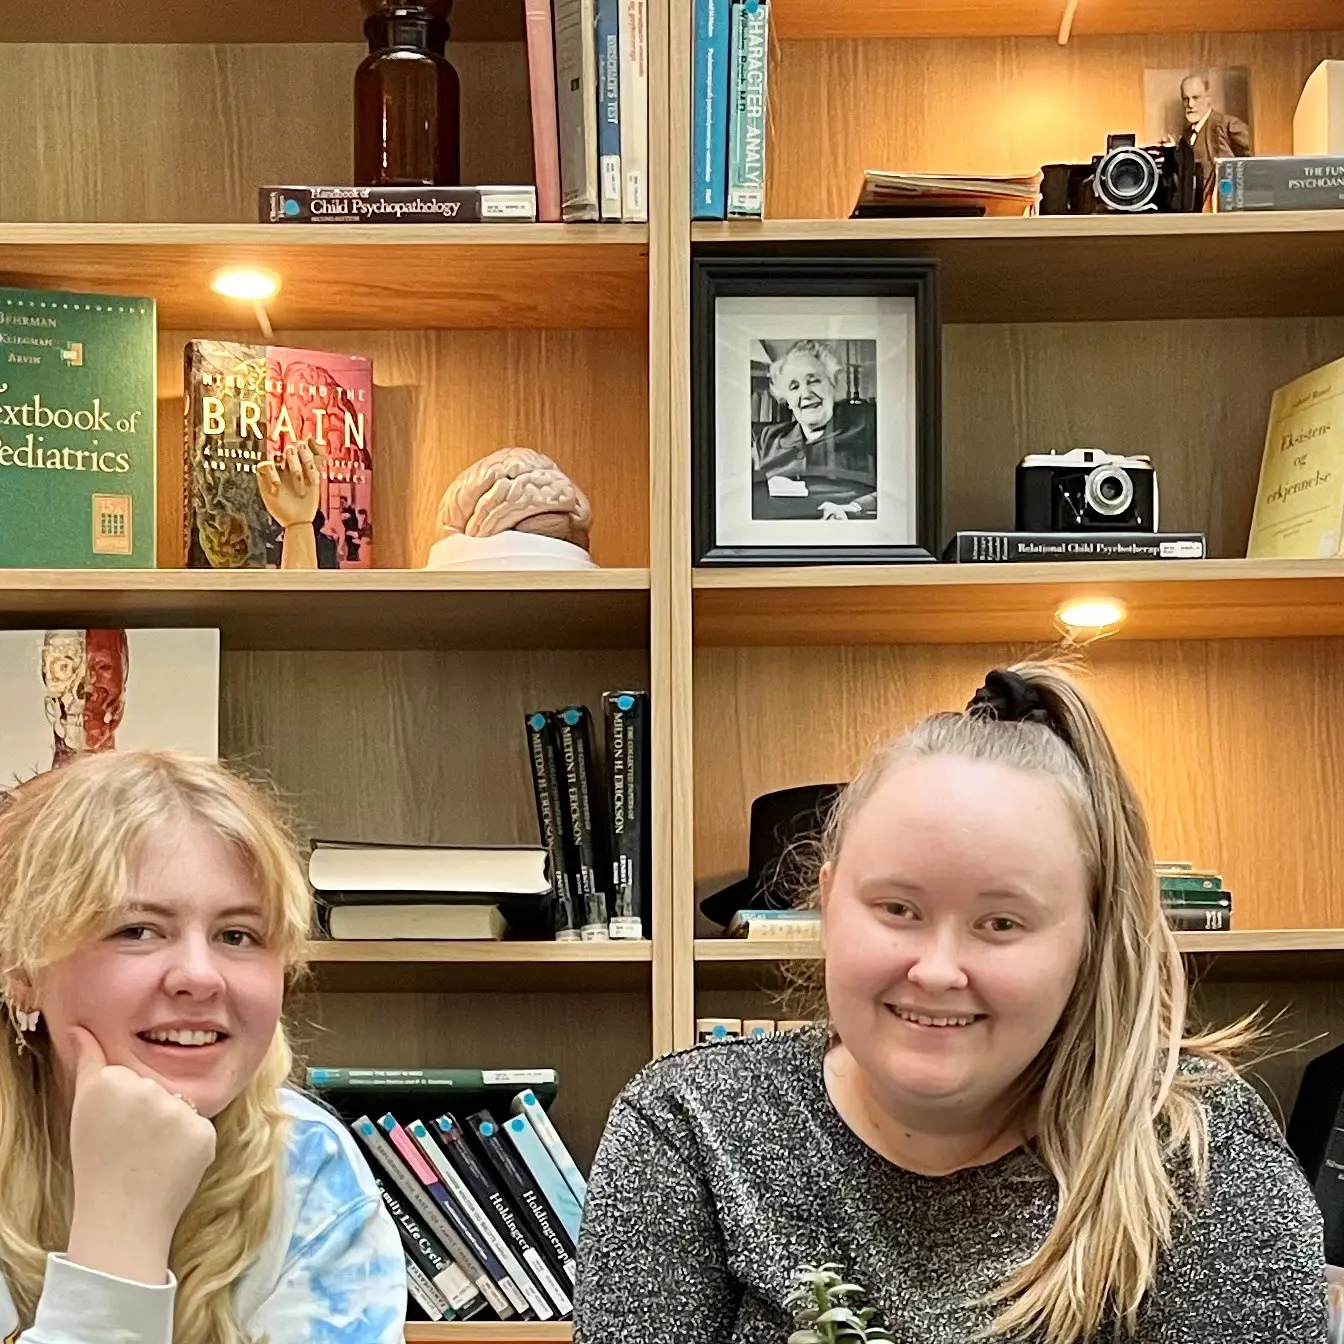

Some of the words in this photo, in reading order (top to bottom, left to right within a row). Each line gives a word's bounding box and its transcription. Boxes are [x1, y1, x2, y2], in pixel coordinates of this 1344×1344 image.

[746, 8, 764, 118] CHARACTER
[1303, 166, 1324, 177] THE
[310, 188, 359, 199] Handbook
[361, 188, 371, 199] of
[310, 198, 348, 215] Child
[353, 198, 461, 217] Psychopathology
[202, 372, 256, 391] MINDS
[336, 386, 365, 401] THE
[116, 411, 142, 434] of
[202, 396, 365, 450] BRAIN
[203, 460, 226, 471] AND
[1292, 452, 1309, 468] og
[1018, 542, 1065, 553] Relational
[1067, 542, 1094, 553] Child
[1096, 543, 1160, 556] Psychotherap
[613, 712, 624, 758] MILTON
[532, 732, 545, 777] MILTON
[561, 726, 574, 771] MILTON
[568, 787, 583, 846] ERICKSON
[613, 775, 624, 834] ERICKSON
[400, 1214, 421, 1240] Life
[418, 1238, 446, 1271] Cycle
